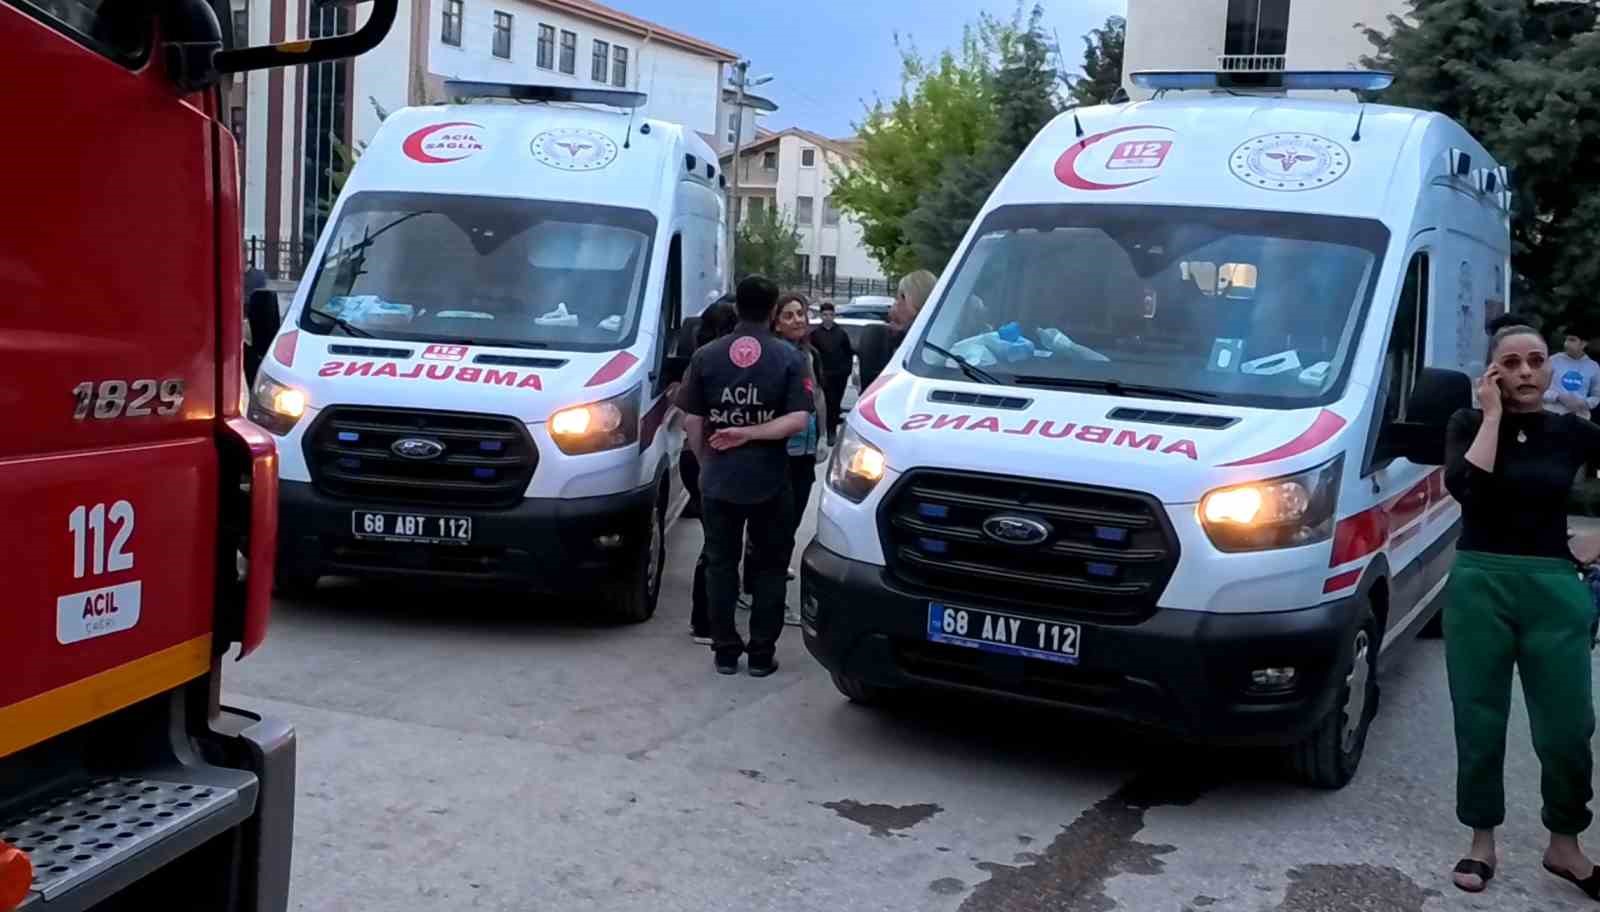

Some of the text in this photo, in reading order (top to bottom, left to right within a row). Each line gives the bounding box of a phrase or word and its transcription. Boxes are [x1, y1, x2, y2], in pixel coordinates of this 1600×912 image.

[1122, 143, 1161, 157] 112
[72, 378, 184, 420] 1829
[721, 383, 763, 405] ACİL
[69, 500, 134, 578] 112
[364, 514, 468, 538] 68 ABT 112
[943, 608, 1076, 654] 68 AAY 112
